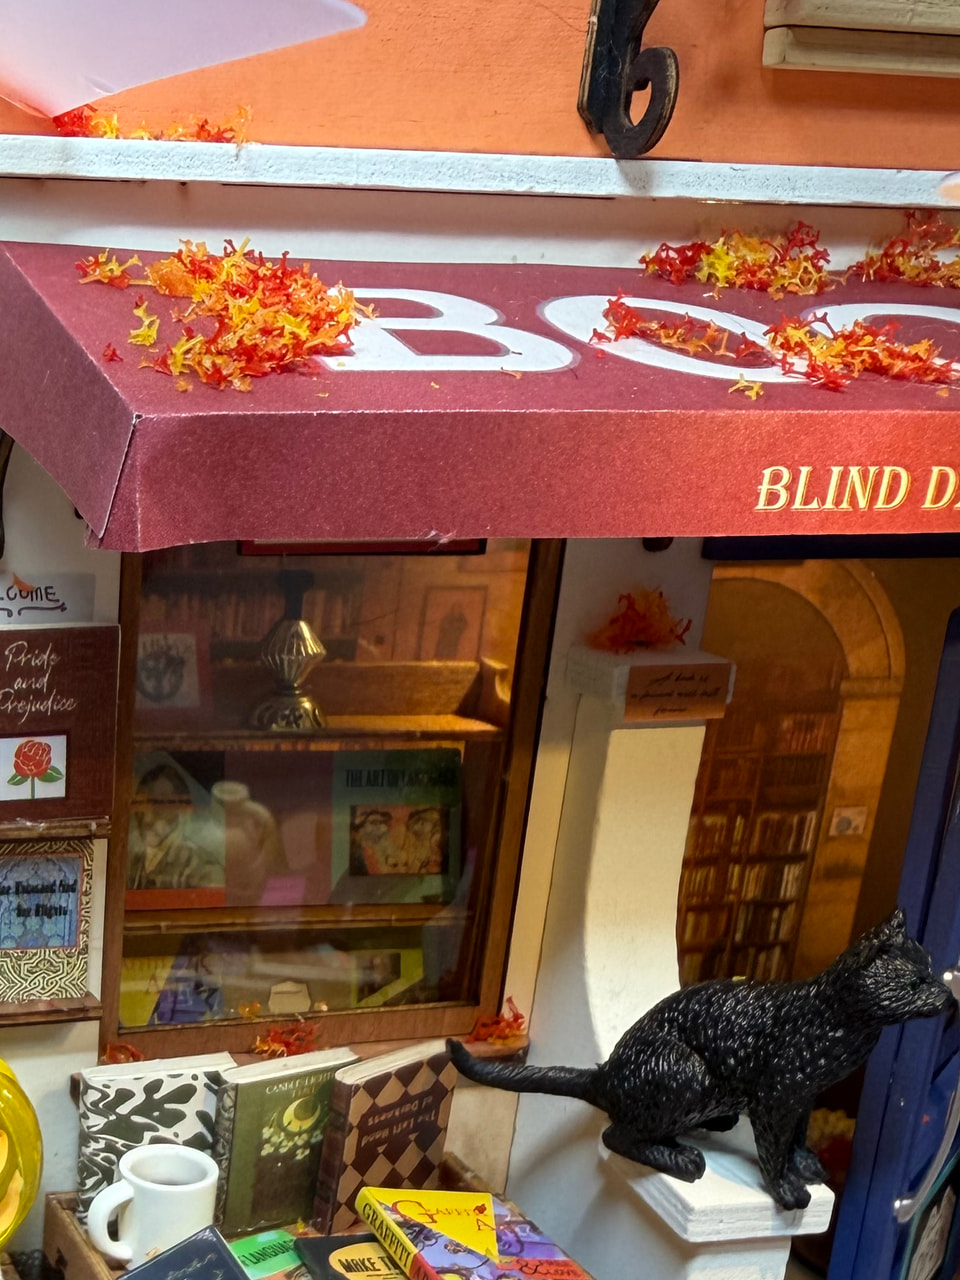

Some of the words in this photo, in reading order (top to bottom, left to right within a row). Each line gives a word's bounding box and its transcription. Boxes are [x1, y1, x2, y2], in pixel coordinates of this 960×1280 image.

[754, 465, 912, 512] BLIND
[921, 465, 960, 511] D
[4, 641, 61, 671] Pride
[14, 667, 51, 693] and
[367, 1100, 420, 1126] Darkness
[361, 1128, 390, 1148] Hand
[392, 1118, 414, 1136] Left
[361, 1202, 412, 1270] GRAFFITI
[338, 1257, 382, 1273] MAKE
